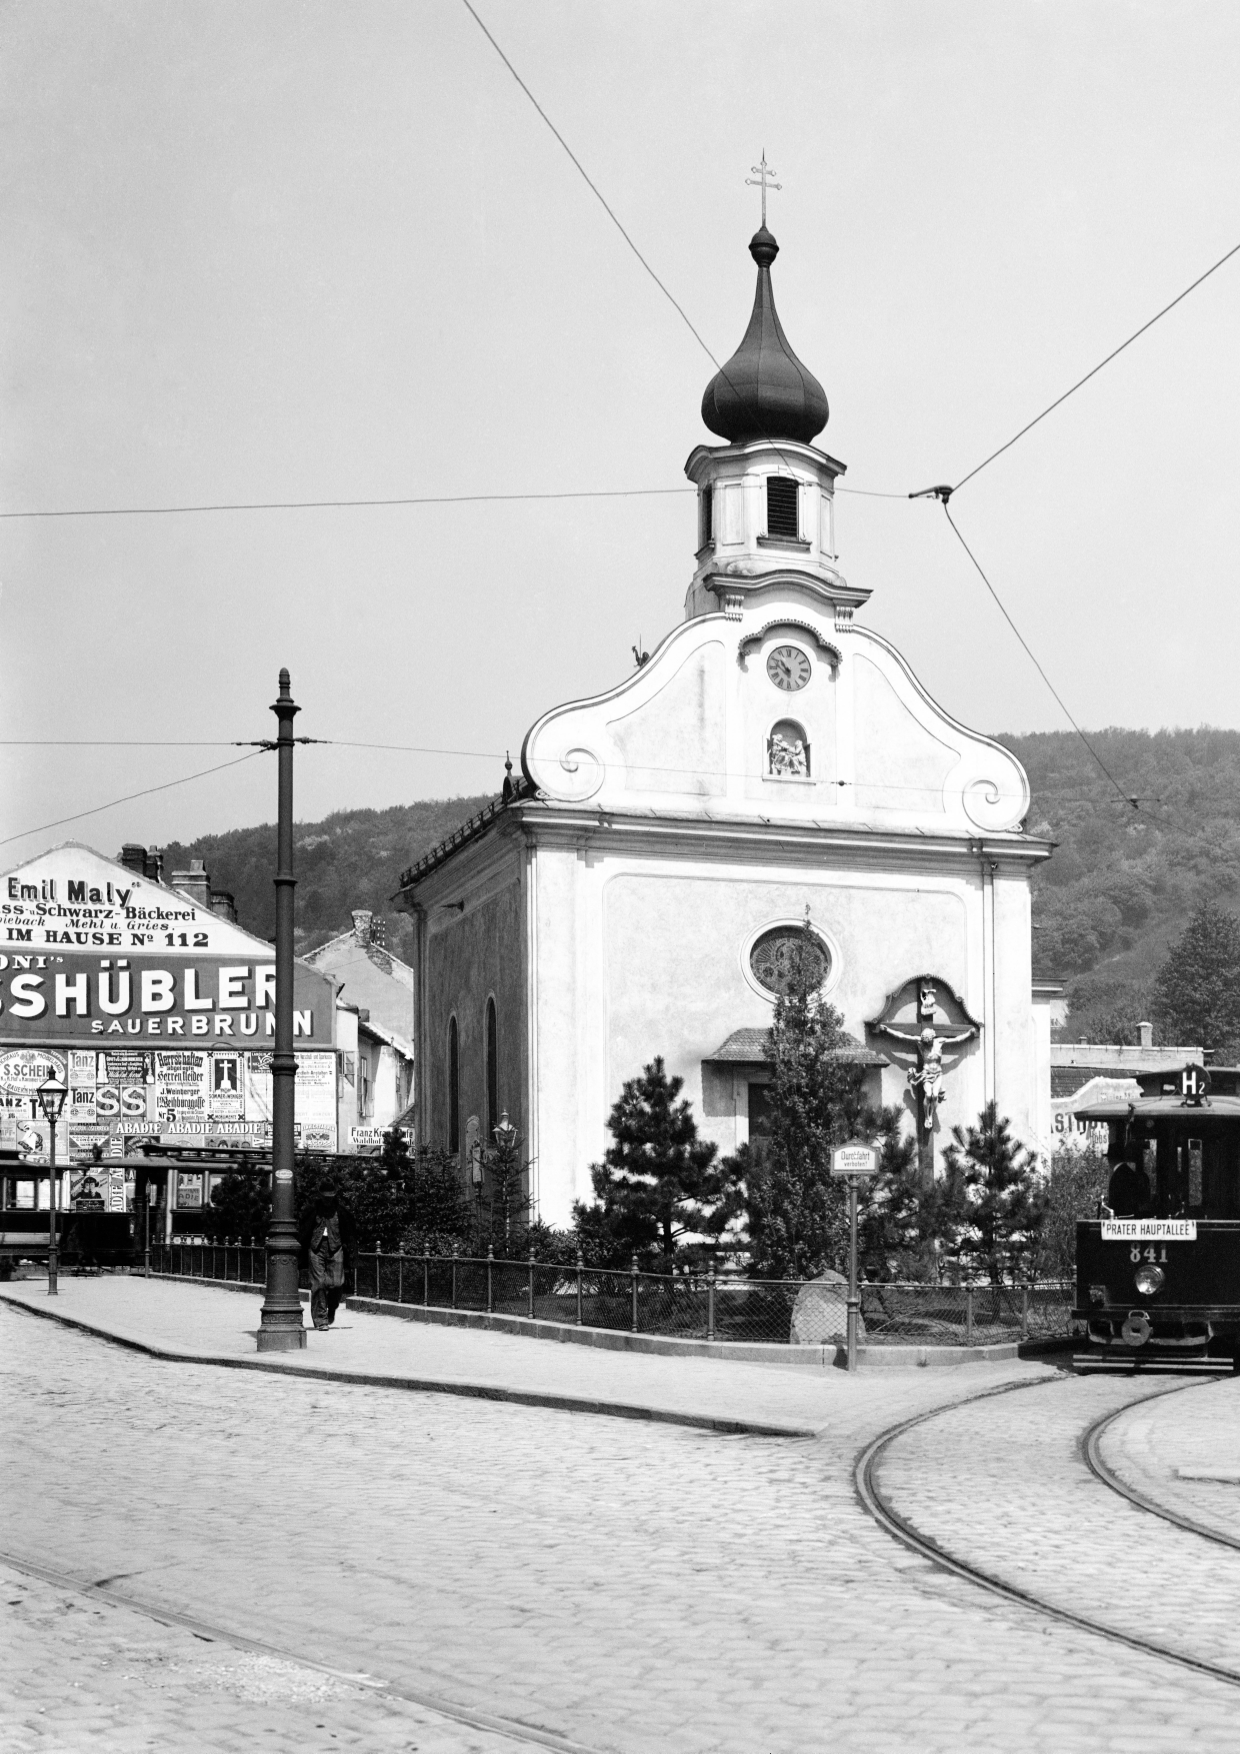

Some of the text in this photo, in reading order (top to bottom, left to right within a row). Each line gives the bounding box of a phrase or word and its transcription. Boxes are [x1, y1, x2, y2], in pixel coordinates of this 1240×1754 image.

[8, 877, 131, 908] Emil Maly
[66, 918, 105, 929] Mehl
[6, 928, 33, 941] IM
[45, 930, 122, 945] HAUSE
[165, 932, 209, 948] 112
[70, 1052, 94, 1068] Tanz
[71, 1088, 95, 1104] Tanz
[166, 1109, 176, 1122] 5
[116, 1122, 161, 1134] ABADIE
[168, 1122, 213, 1134] ABADIE
[216, 1122, 261, 1134] ABADIE
[351, 1126, 373, 1138] Franz
[1106, 1223, 1190, 1236] PRATER HAUPTALLEE
[1129, 1241, 1169, 1263] 841
